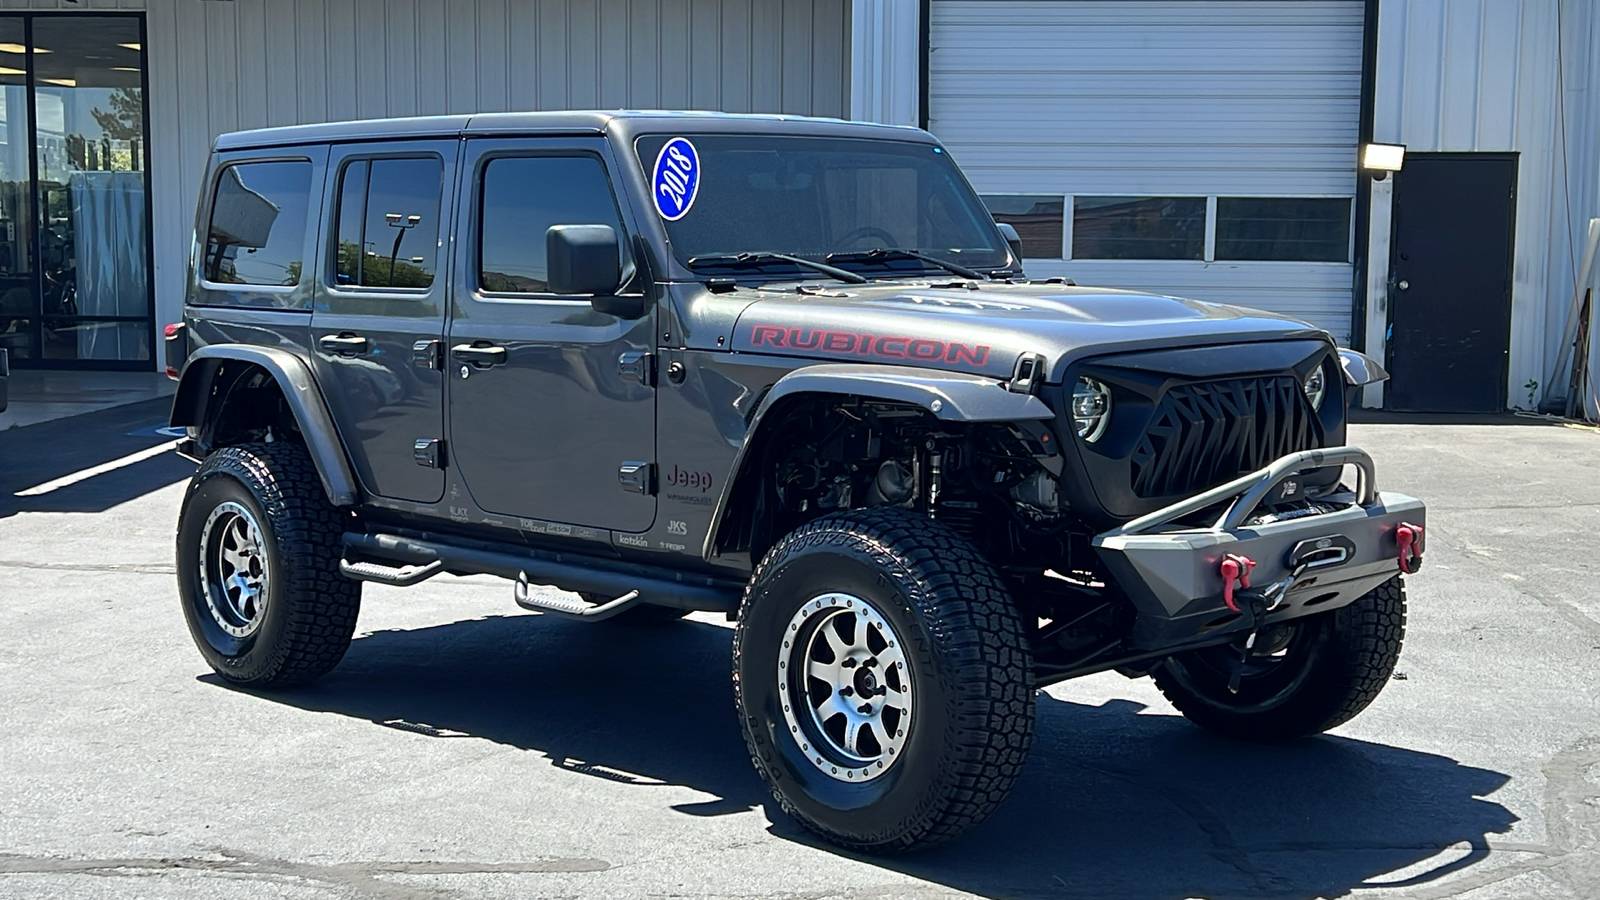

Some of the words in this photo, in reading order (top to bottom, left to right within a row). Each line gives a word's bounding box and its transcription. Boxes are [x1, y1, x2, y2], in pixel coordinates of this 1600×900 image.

[659, 146, 692, 211] 2018
[751, 325, 991, 367] RUBICON
[667, 464, 713, 493] Jeep
[619, 534, 648, 547] katzkin
[667, 520, 687, 535] JKS
